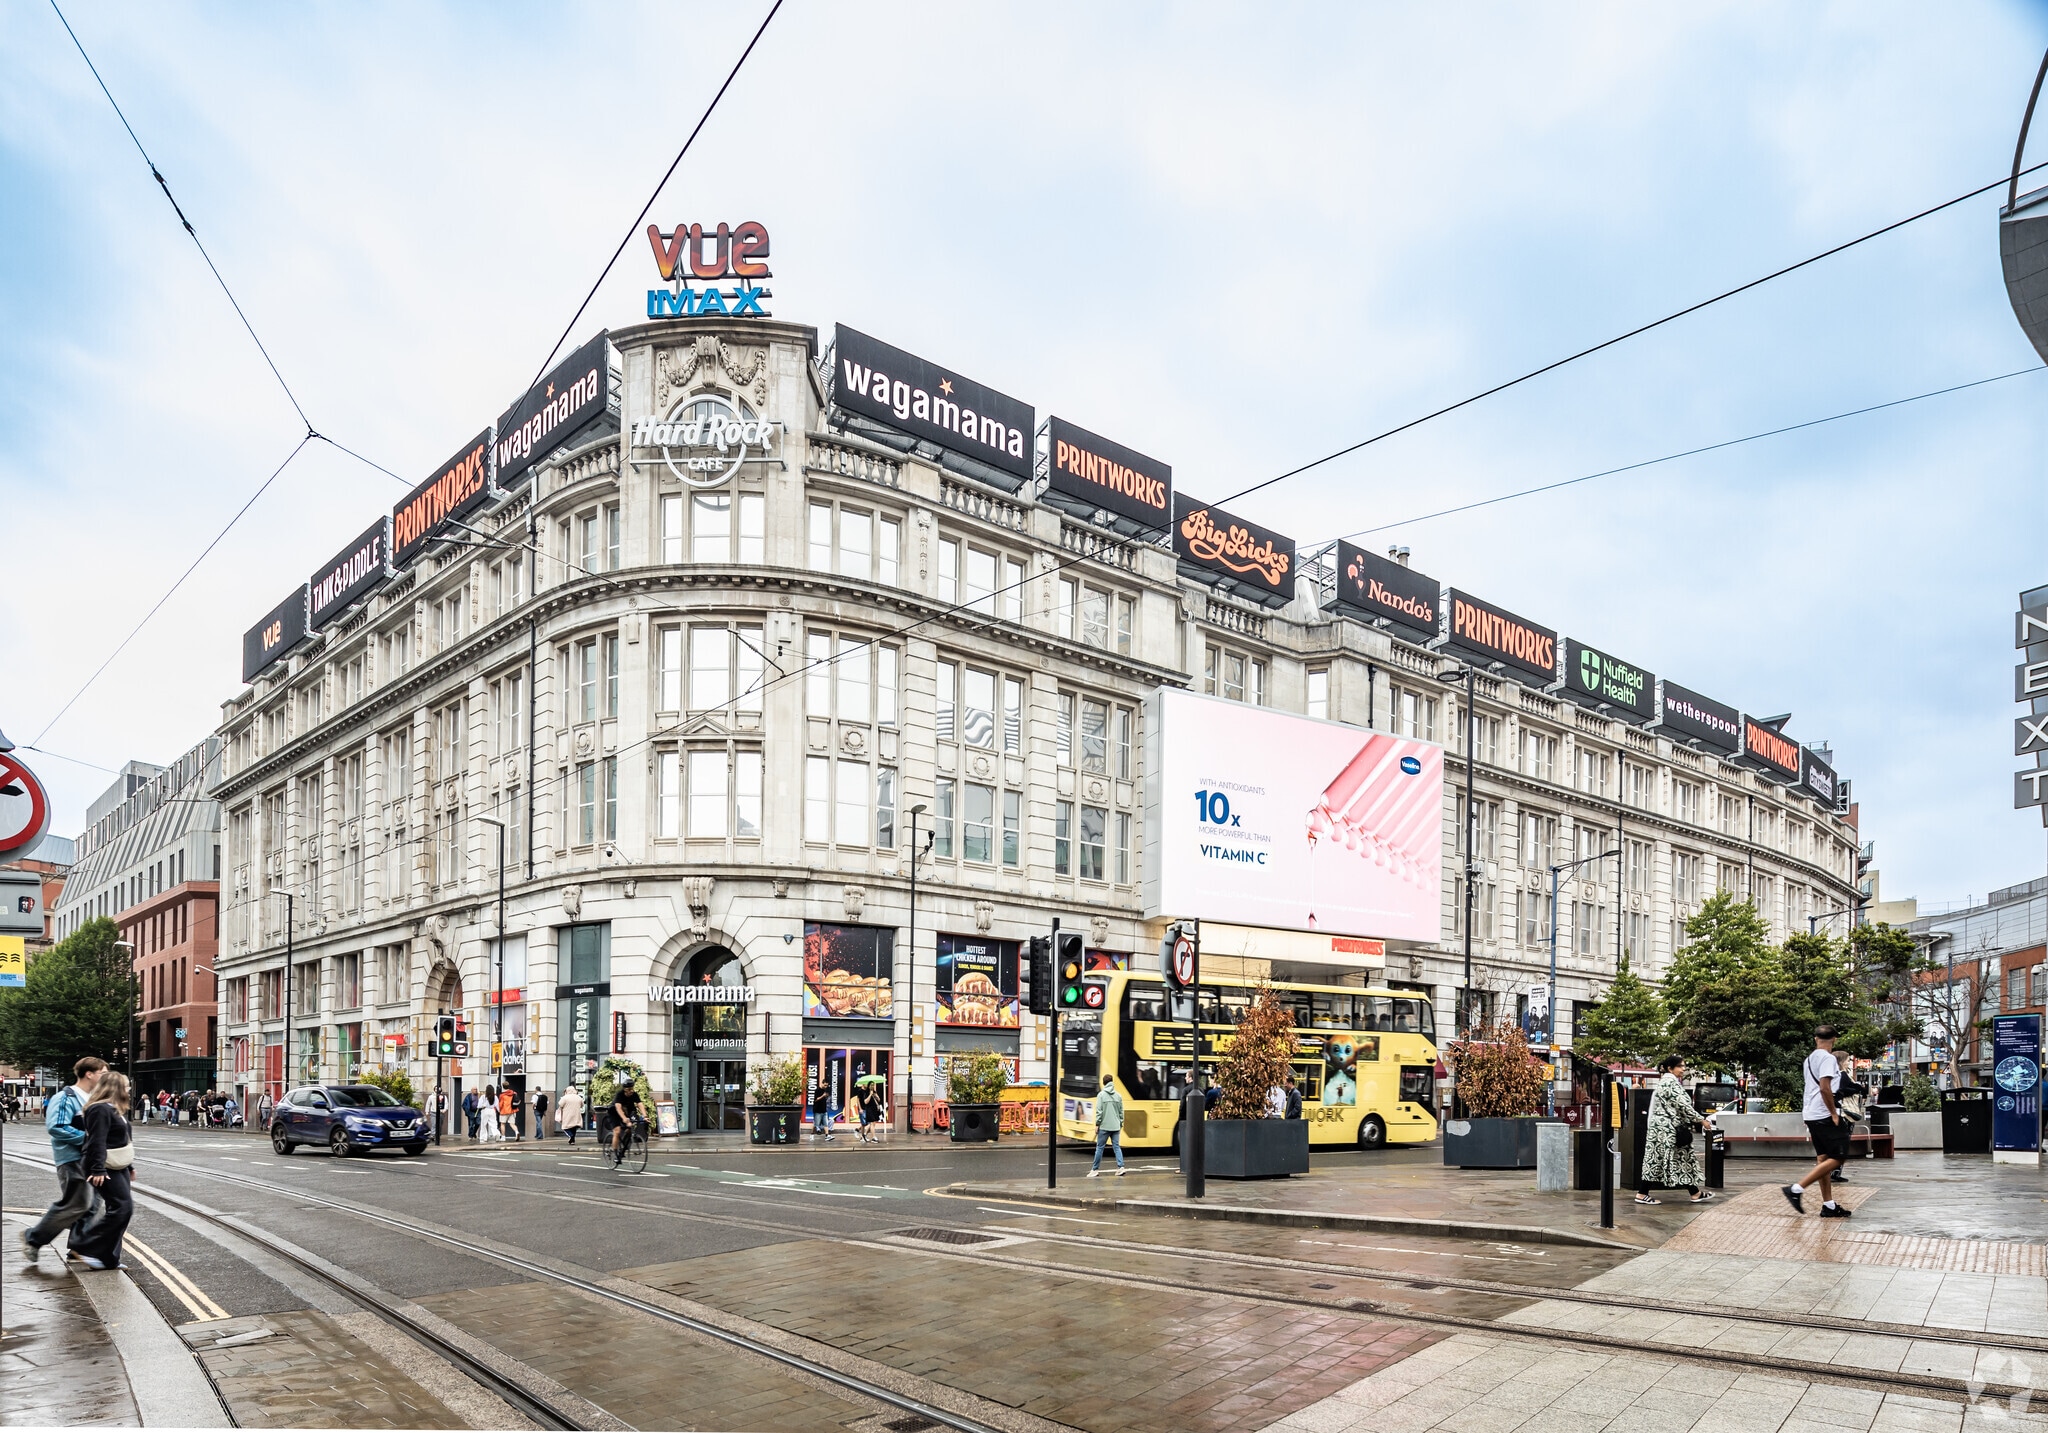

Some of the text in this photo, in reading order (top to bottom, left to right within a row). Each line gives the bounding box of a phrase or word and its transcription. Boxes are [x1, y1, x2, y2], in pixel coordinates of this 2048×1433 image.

[647, 221, 770, 281] vue
[647, 287, 765, 318] IMAX
[499, 368, 599, 469] wagamama
[843, 359, 1025, 459] wagamama
[633, 411, 775, 454] Hard Rock
[688, 457, 724, 472] CAFE
[1057, 440, 1166, 510] PRINTWORKS
[395, 443, 485, 554] PRINTWORKS
[1368, 578, 1433, 622] Nando's
[262, 620, 282, 652] vue
[1455, 599, 1553, 670] PRINTWORKS
[1603, 658, 1643, 690] Nuffield
[1603, 677, 1637, 706] Health
[2021, 606, 2048, 800] NEXT
[1667, 697, 1737, 736] wetherspoon
[1747, 722, 1798, 773] PRINTWORKS
[1199, 777, 1266, 796] WITH ANTIOXIDANTS
[1199, 826, 1271, 843] MORE POWERFUL THAN
[1200, 844, 1254, 863] VITAMIN
[965, 945, 986, 955] HOTTEST
[648, 985, 755, 1006] wagamama
[695, 1038, 748, 1049] wagamama
[808, 1064, 818, 1077] US!
